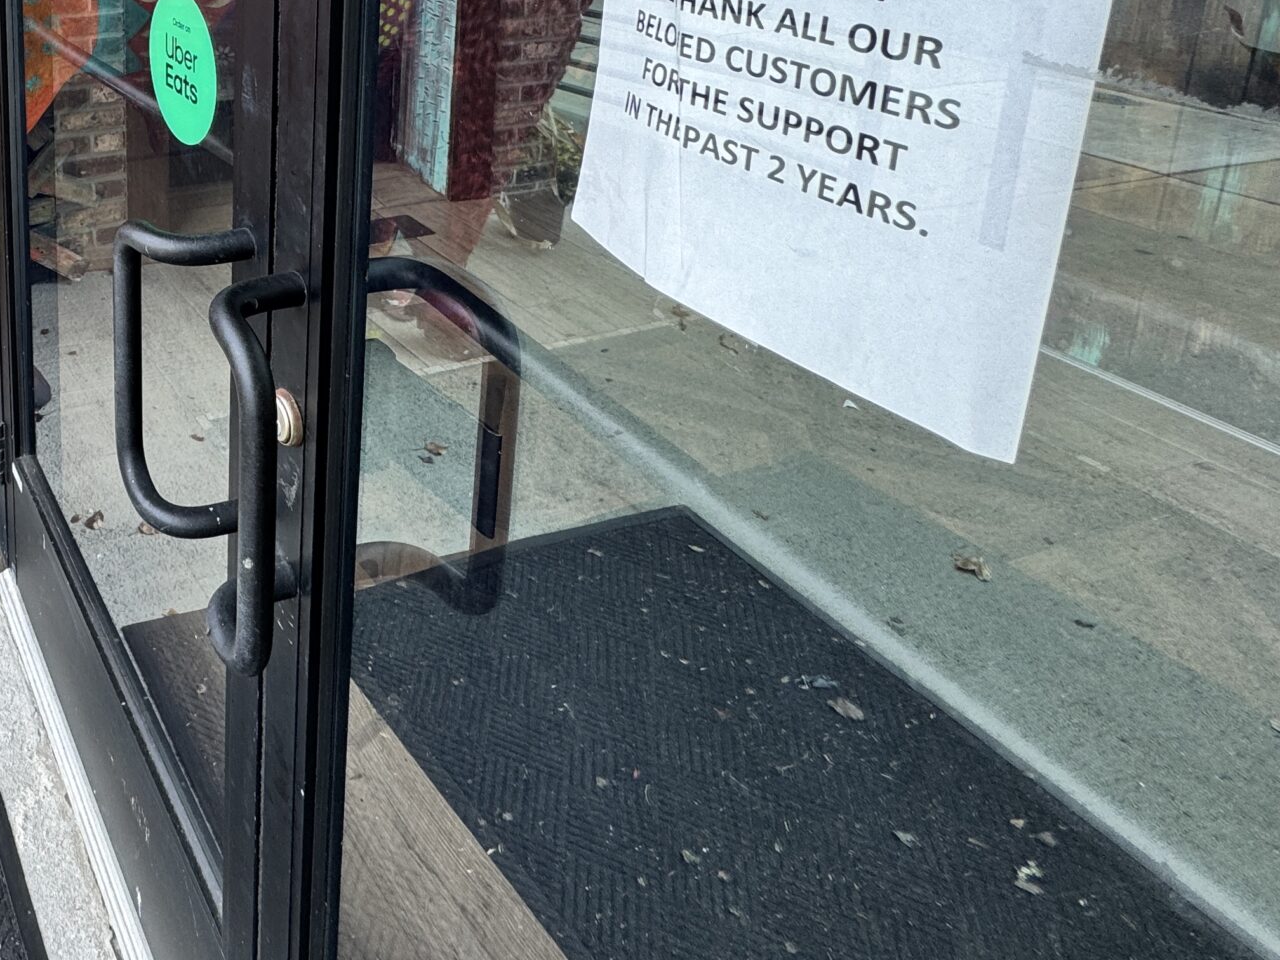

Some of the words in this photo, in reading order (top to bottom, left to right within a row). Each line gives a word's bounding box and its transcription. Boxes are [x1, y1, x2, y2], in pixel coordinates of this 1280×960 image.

[165, 32, 198, 74] Uber
[635, 8, 716, 64] BELOED
[725, 44, 962, 131] CUSTOMERS
[775, 7, 835, 47] ALL
[848, 22, 944, 70] OUR
[165, 62, 198, 105] Eats
[642, 56, 680, 96] FOR
[679, 77, 729, 117] THE
[737, 96, 909, 172] SUPPORT
[624, 90, 642, 121] IN
[682, 124, 760, 173] PAST
[767, 154, 786, 185] 2
[796, 162, 930, 238] YEARS.
